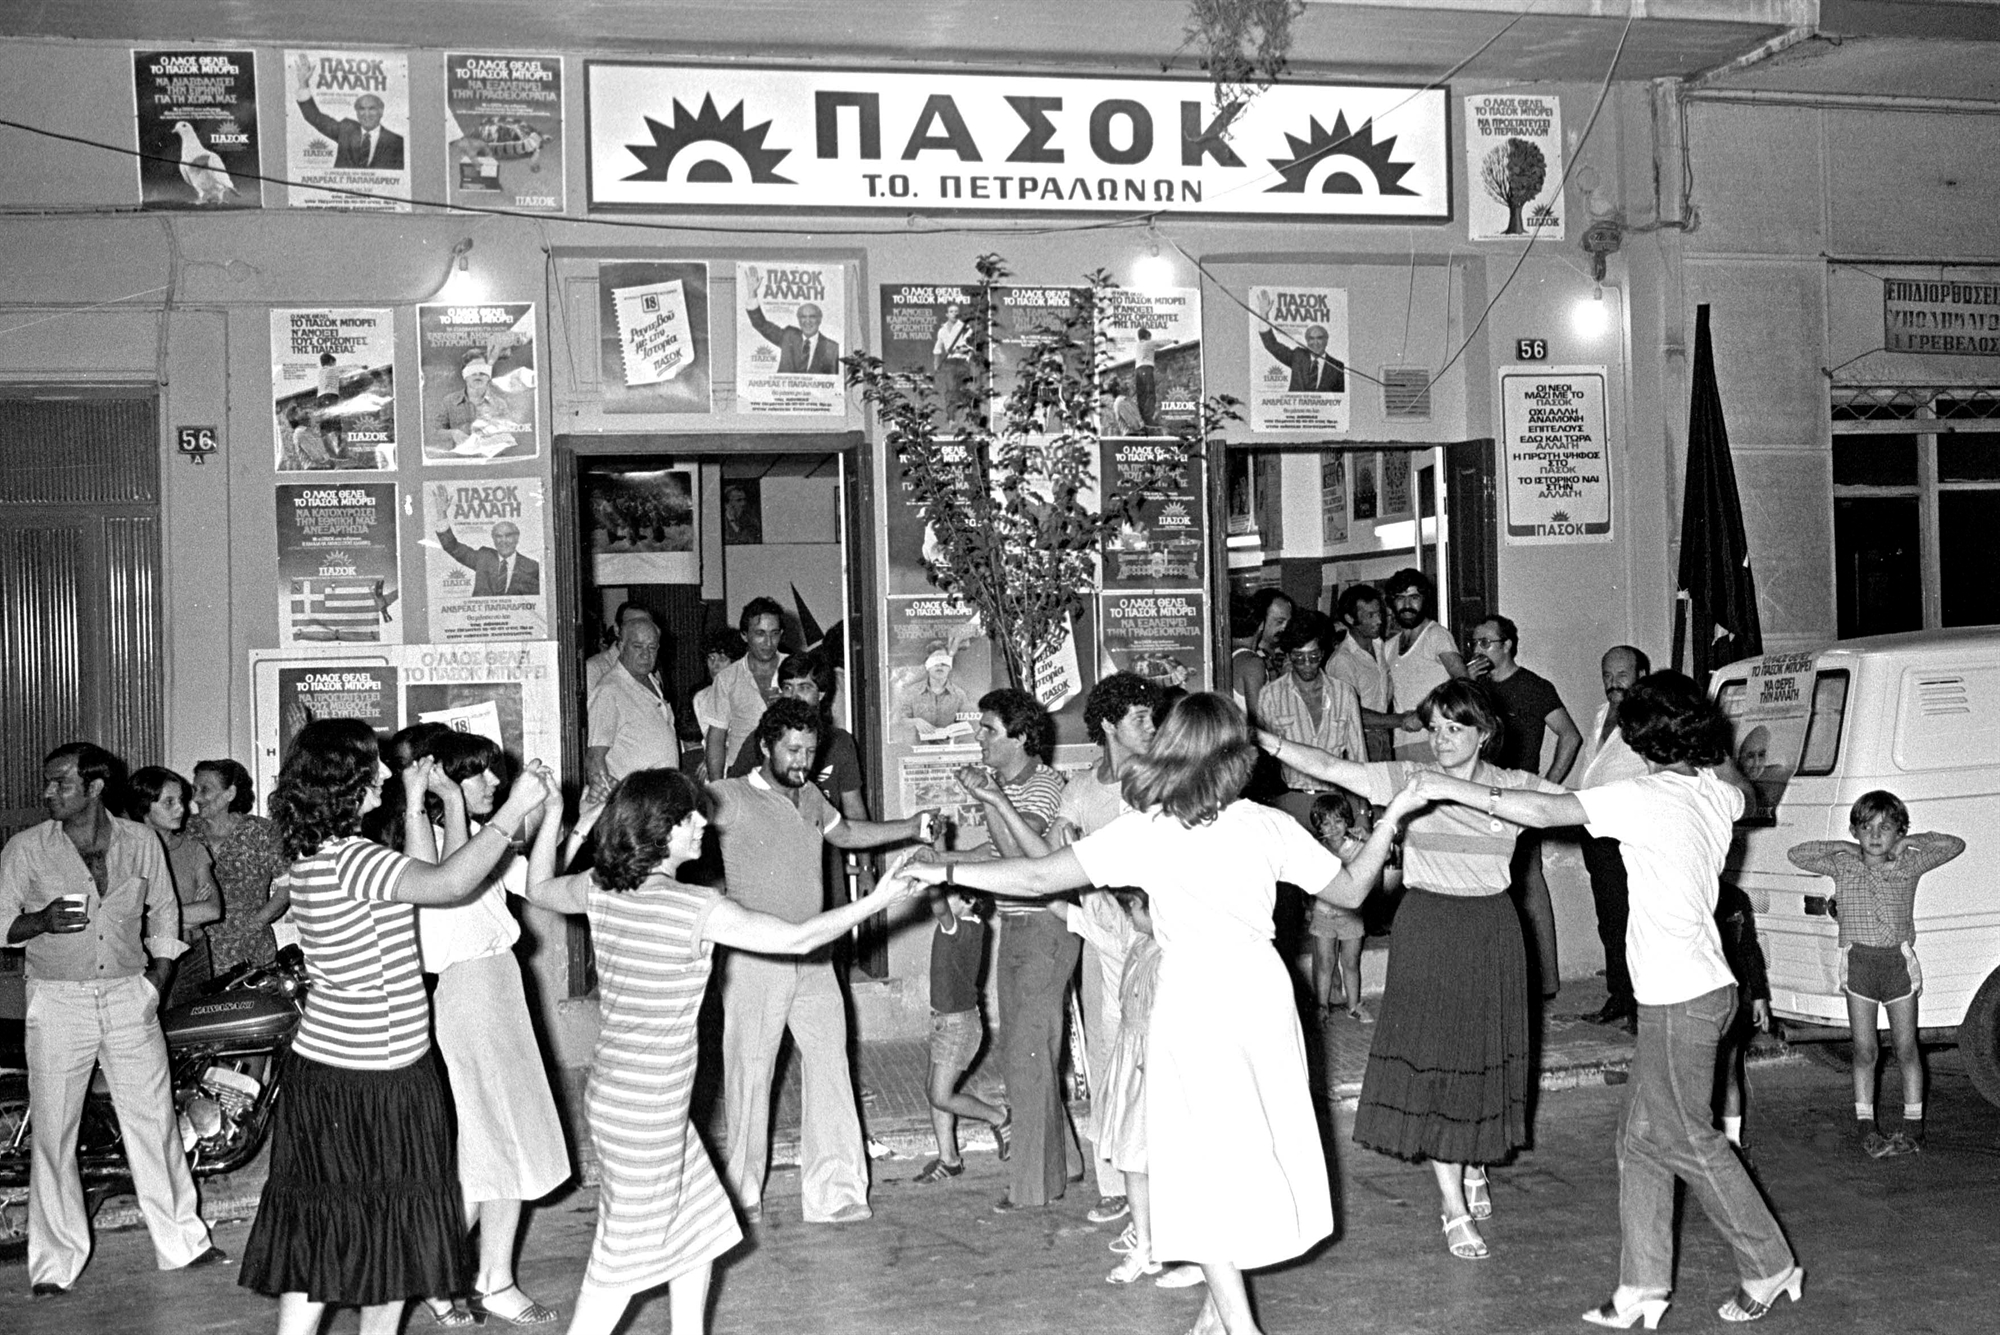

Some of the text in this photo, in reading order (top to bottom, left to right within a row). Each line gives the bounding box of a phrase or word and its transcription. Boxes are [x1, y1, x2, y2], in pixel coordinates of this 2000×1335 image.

[160, 56, 169, 66] Ο
[170, 56, 197, 66] ΛΑΟΣ
[466, 59, 476, 69] Ο
[478, 59, 507, 70] ΛΑΟΣ
[150, 65, 239, 74] ΤΟ ΠΑΣΟΚ ΜΠΟΡΕΙ
[320, 57, 384, 76] ΠΑΣΟΚ
[456, 68, 553, 81] ΤΟ ΠΑΣΟΚ ΜΠΟΡΕΙ
[156, 77, 170, 86] ΝΑ
[316, 74, 387, 92] ΑΛΛΑΓΗ
[468, 80, 541, 92] ΝΑ ΕΞΑΛΕΙΨΕΙ
[167, 85, 225, 96] ΤΗΝ ΕΙΡΗΝΗ
[452, 88, 557, 102] ΤΗΝ ΓΡΑΦΕΙΟΚΡΑΤΙΑ
[154, 94, 237, 104] ΓΙΑ ΤΗ ΧΩΡΑ ΜΑΣ
[1483, 99, 1491, 108] Ο
[1493, 99, 1516, 108] ΛΑΟΣ
[1475, 106, 1553, 117] ΤΟ ΠΑΣΟΚ ΜΠΟΡΕΙ
[813, 89, 1247, 168] ΠΑΣΟΚ
[1477, 118, 1550, 129] ΝΑ ΠΡΟΣΤΑΤΕΥΣΕΙ
[1481, 127, 1549, 137] ΤΟ ΠΕΡΙΒΑΛΛΟΝ
[210, 133, 249, 144] ΠΑΣΟΚ
[862, 173, 1203, 204] Τ.Ο. ΠΕΤΡΑΛΩΝΩΝ
[515, 196, 556, 207] ΠΑΣΟΚ
[1527, 217, 1560, 228] ΠΑΣΟΚ
[767, 269, 823, 286] ΠΑΣΟΚ
[763, 284, 825, 301] ΑΛΛΑΓΗ
[644, 295, 657, 310] 18
[1125, 296, 1186, 306] ΠΑΣΟΚ ΜΠΟΡΕΙ
[1276, 292, 1328, 308] ΠΑΣΟΚ
[1135, 313, 1179, 322] ΟΡΙΖΟΝΤΕΣ
[1274, 307, 1330, 323] ΑΛΛΑΓΗ
[290, 319, 377, 328] ΤΟ ΠΑΣΟΚ ΜΠΟΡΕΙ
[291, 337, 368, 346] ΤΟΥΣ ΟΡΙΖΟΝΤΕΣ
[291, 346, 357, 354] ΤΗΣ ΠΑΙΔΕΙΑΣ
[1520, 339, 1545, 359] 56
[653, 347, 684, 370] ΠΑΣΟΚ
[1536, 384, 1573, 393] ΟΙ ΝΕΟΙ
[1524, 391, 1585, 400] ΜΑΖΙ ΜΕ ΤΟ
[1161, 401, 1197, 411] ΠΑΣΟΚ
[1536, 398, 1573, 407] ΠΑΣΟΚ
[1528, 408, 1579, 416] ΟΧΙ ΑΛΛΗ
[1528, 415, 1585, 423] ΑΝΑΜΟΝΗ
[1528, 425, 1585, 433] ΕΠΙΤΕΛΟΥΣ
[182, 429, 212, 450] 56
[347, 431, 388, 442] ΠΑΣΟΚ
[1520, 435, 1592, 444] ΕΔΩ ΚΑΙ ΤΩΡΑ
[1535, 442, 1580, 450] ΑΛΛΑΓΗ
[1513, 451, 1601, 461] Η ΠΡΩΤΗ ΨΗΦΟΣ
[1548, 459, 1569, 467] ΣΤΟ
[1539, 466, 1577, 475] ΠΑΣΟΚ
[1518, 475, 1600, 485] ΤΟ ΙΣΤΟΡΙΚΟ ΝΑΙ
[1546, 483, 1574, 491] ΣΤΗΝ
[303, 490, 311, 499] Ο
[312, 490, 337, 499] ΛΑΟΣ
[456, 485, 518, 503] ΠΑΣΟΚ
[1538, 490, 1583, 499] ΑΛΛΑΓΗ
[294, 497, 376, 507] ΤΟ ΠΑΣΟΚ ΜΠΟΡΕΙ
[296, 508, 376, 518] ΝΑ ΚΑΤΟΧΥΡΩΣΕΙ
[454, 501, 521, 519] ΑΛΛΑΓΗ
[295, 516, 377, 526] ΤΗΝ ΕΘΝΙΚΗ ΜΑΣ
[1158, 516, 1192, 526] ΠΑΣΟΚ
[303, 526, 369, 535] ΑΝΕΞΑΡΤΗΣΙΑ
[1536, 523, 1585, 537] ΠΑΣΟΚ
[318, 566, 357, 576] ΠΑΣΟΚ
[1119, 599, 1128, 609] Ο
[1129, 599, 1156, 609] ΛΑΟΣ
[1110, 607, 1197, 618] ΤΟ ΠΑΣΟΚ ΜΠΟΡΕΙ
[1121, 618, 1187, 628] ΝΑ ΕΞΑΛΕΙΨΕΙ
[1107, 627, 1200, 638] ΤΗΝ ΓΡΑΦΕΙΟΚΡΑΤΙΑ
[421, 650, 481, 666] Ο ΛΑΟΣ
[305, 673, 314, 683] Ο
[315, 673, 340, 683] ΛΑΟΣ
[405, 665, 548, 682] ΤΟ ΠΑΣΟΚ ΜΠΟΡΕΙ
[296, 681, 381, 691] ΤΟ ΠΑΣΟΚ ΜΠΟΡΕΙ
[1041, 679, 1070, 703] ΠΑΣΟΚ
[298, 692, 380, 702] ΝΑ ΠΡΟΣΤΑΤΕΥΣΕΙ
[329, 701, 372, 710] ΜΙΣΘΟΥΣ
[332, 709, 381, 718] ΣΥΝΤΑΞΕΙΣ
[956, 712, 983, 721] ΠΑΣΟ
[454, 719, 468, 733] 18
[190, 1000, 255, 1015] KAWASAKI
